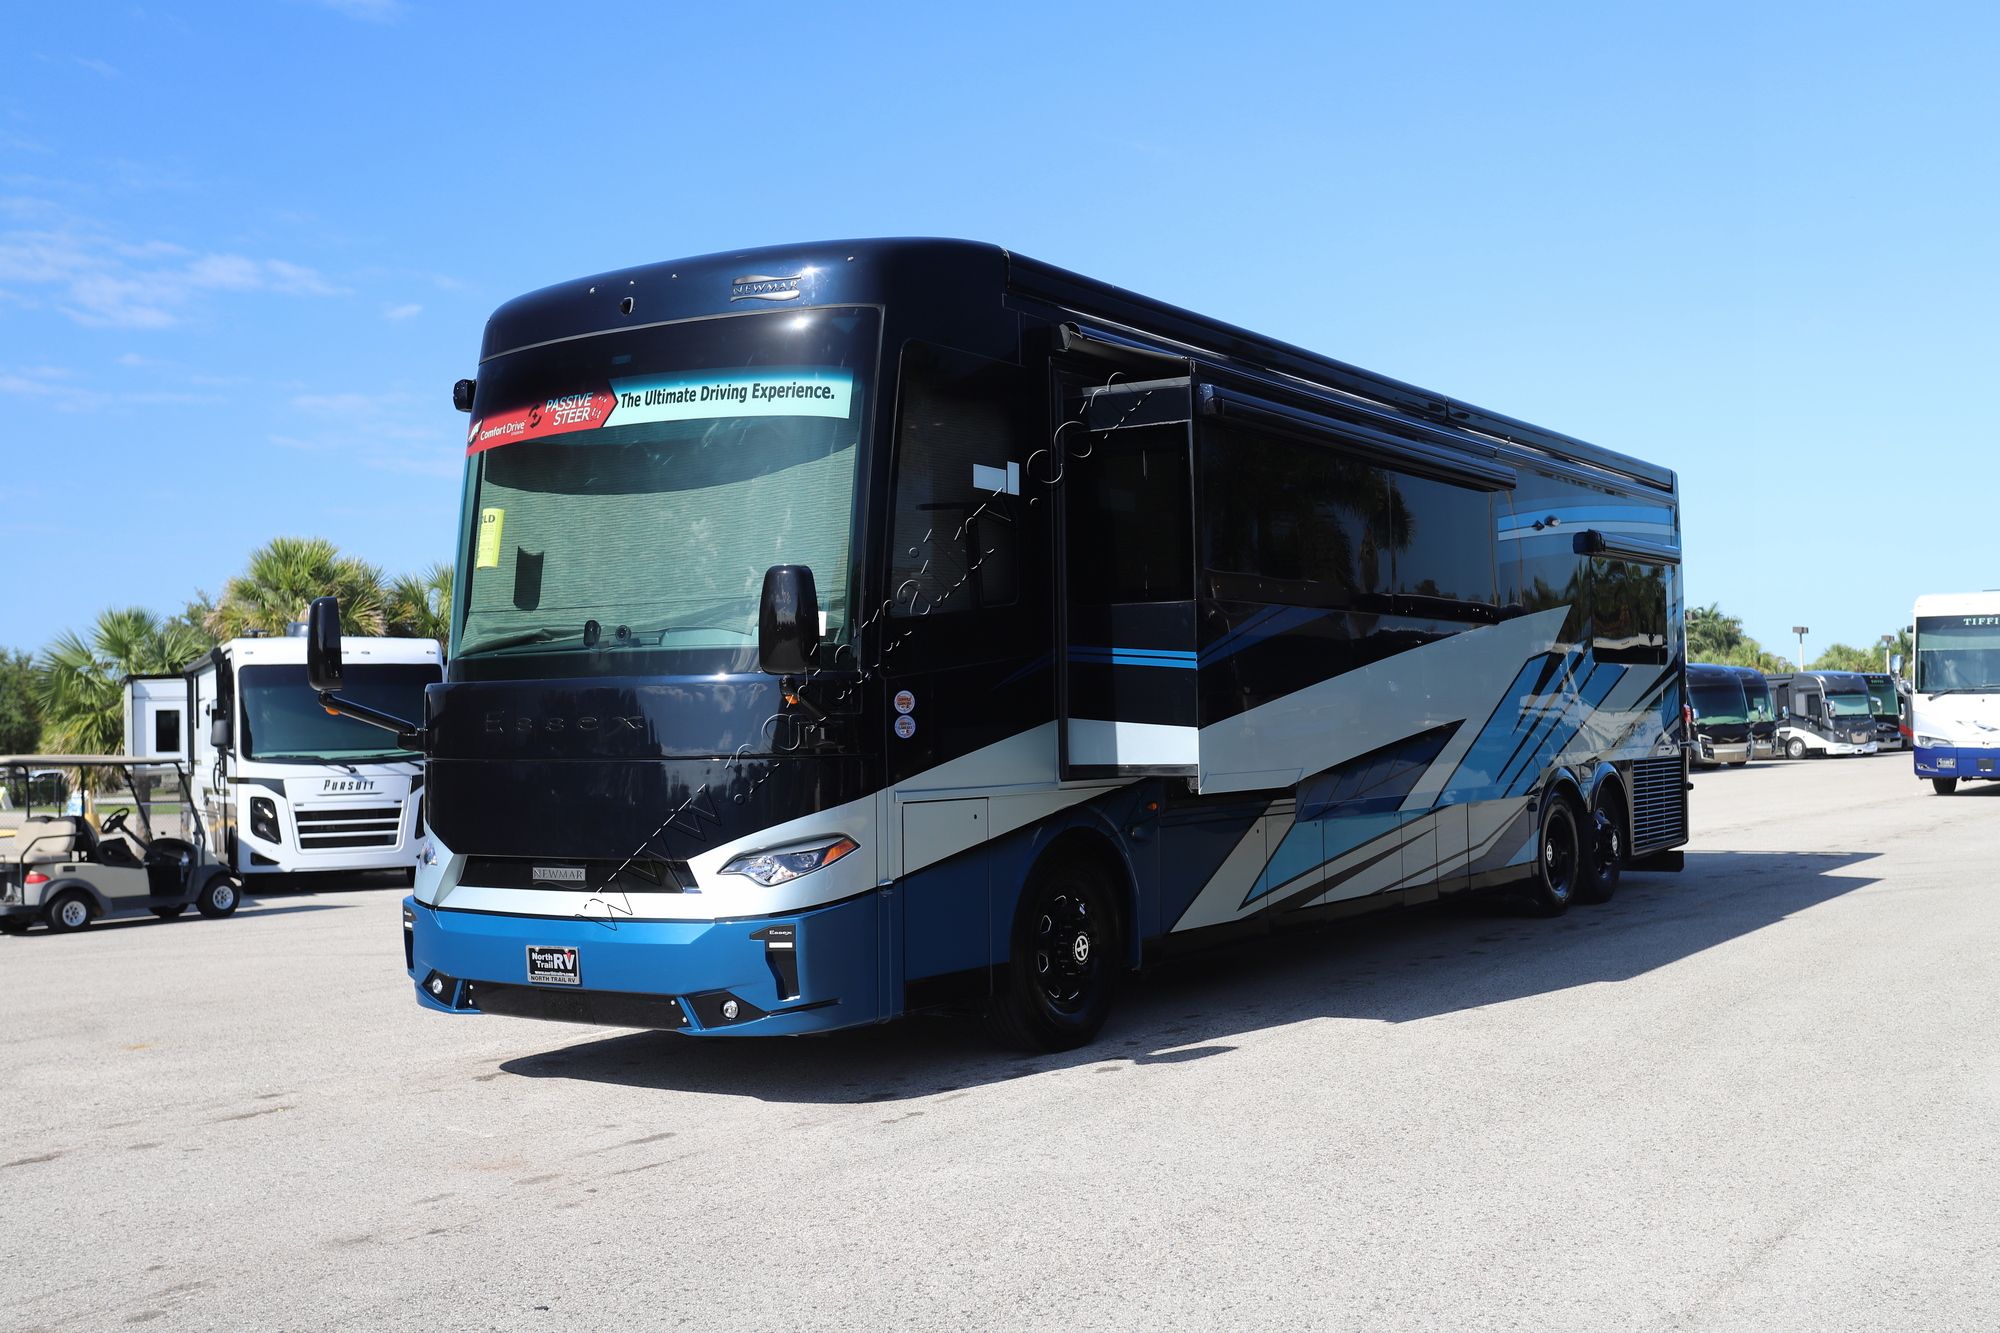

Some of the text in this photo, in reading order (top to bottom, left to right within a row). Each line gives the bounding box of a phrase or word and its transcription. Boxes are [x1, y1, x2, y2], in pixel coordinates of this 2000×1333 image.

[733, 280, 798, 295] NEWMAR
[545, 392, 593, 413] PASSIVE
[621, 382, 835, 408] The Ultimate Driving Experience.
[553, 407, 590, 426] STEER
[480, 425, 506, 441] Comfort
[506, 421, 525, 433] Drive
[533, 868, 585, 880] NEWMAR
[531, 952, 575, 970] North RV
[536, 960, 554, 969] Trail
